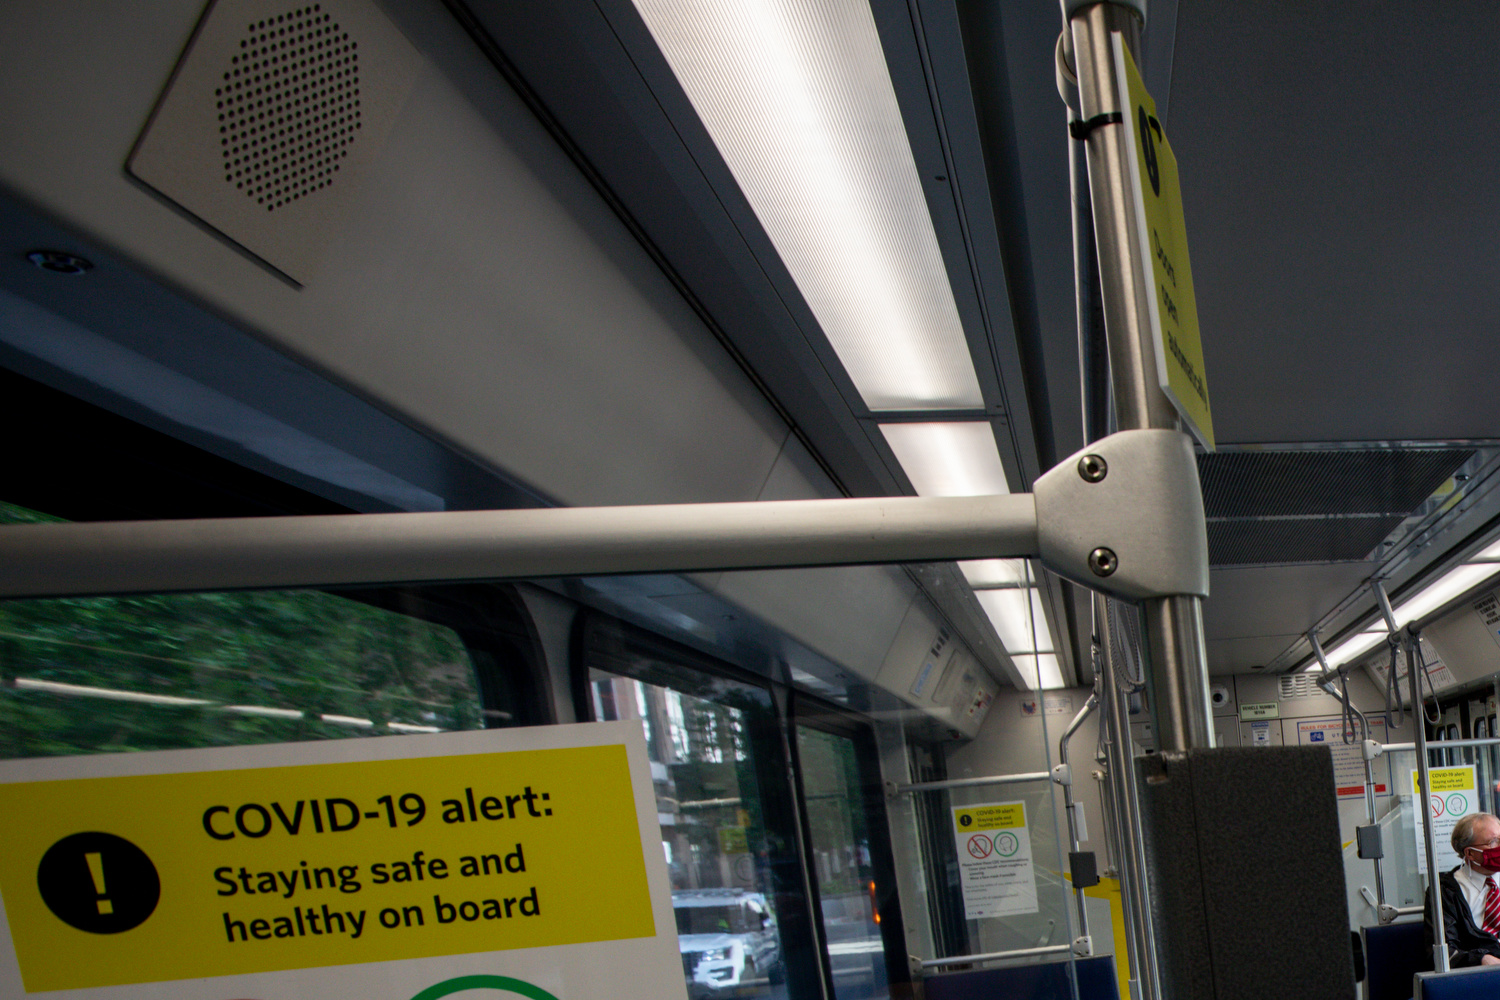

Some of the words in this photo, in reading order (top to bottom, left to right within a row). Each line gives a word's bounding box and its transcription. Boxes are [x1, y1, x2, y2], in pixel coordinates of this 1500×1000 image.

[202, 793, 426, 841] COVID-19
[441, 786, 552, 824] alert:
[214, 860, 362, 899] Staying
[371, 851, 449, 884] safe
[460, 843, 526, 877] and
[223, 904, 366, 942] healthy
[379, 906, 424, 929] on
[434, 887, 540, 924] board
